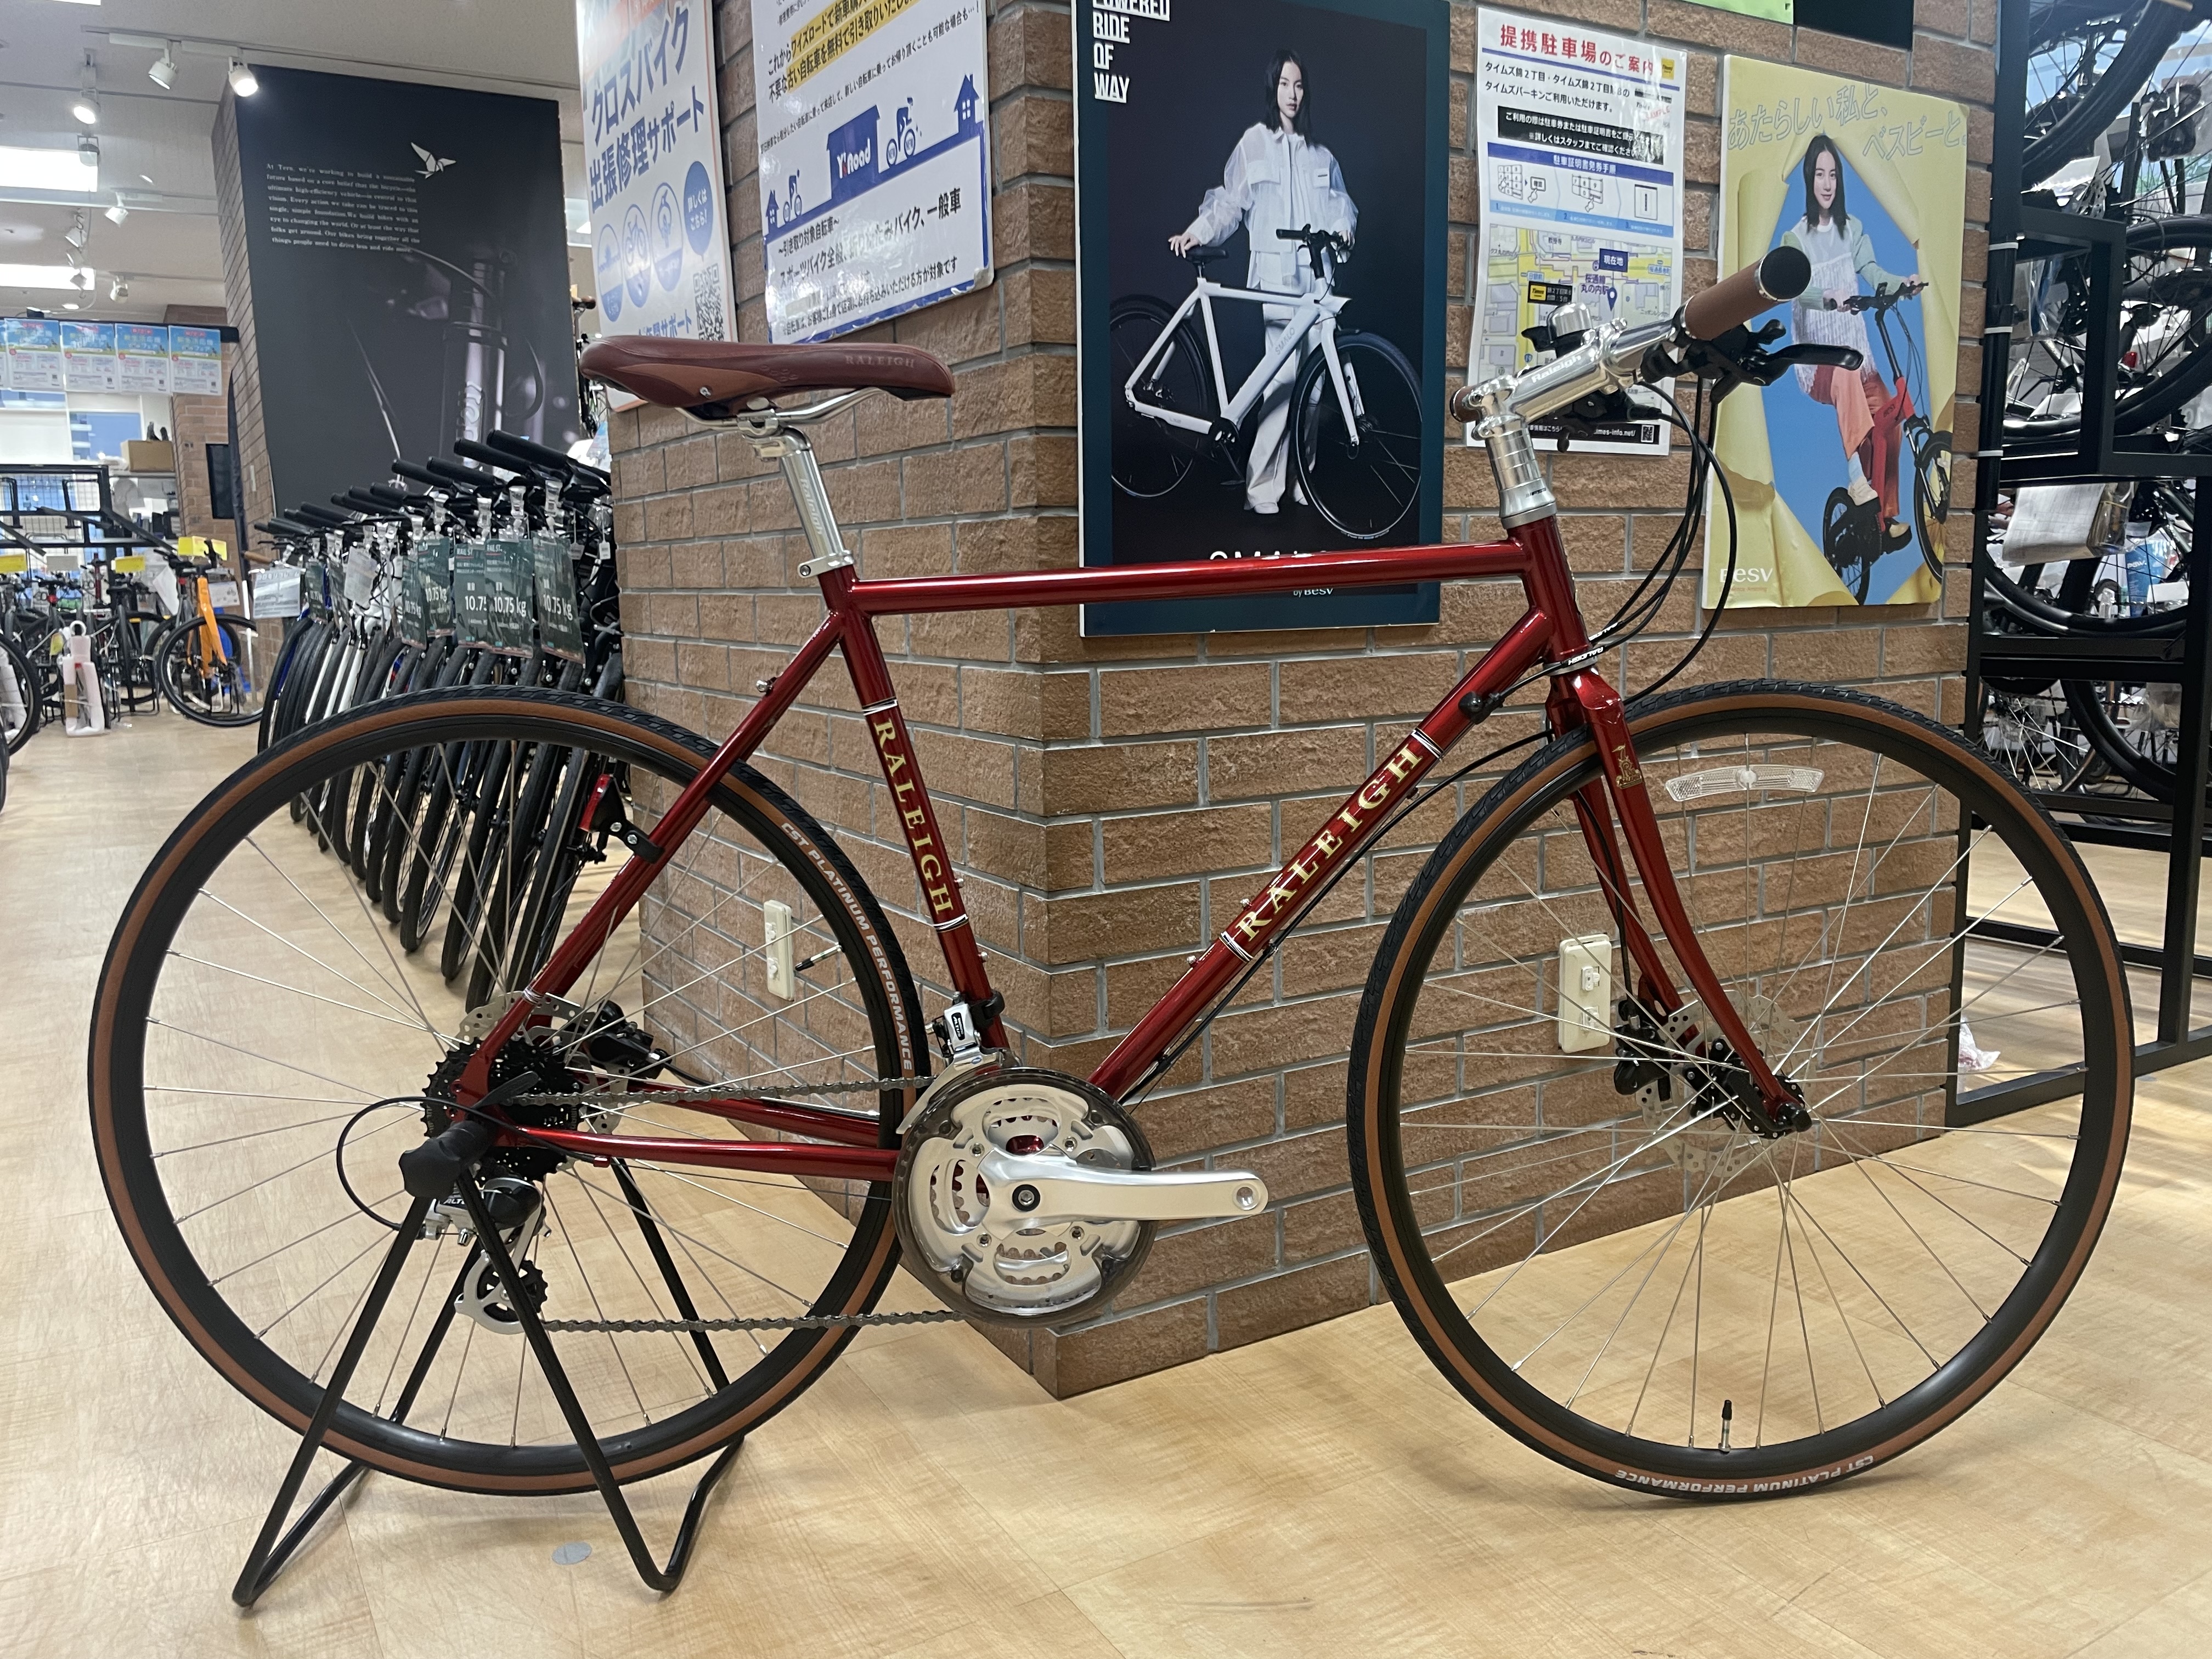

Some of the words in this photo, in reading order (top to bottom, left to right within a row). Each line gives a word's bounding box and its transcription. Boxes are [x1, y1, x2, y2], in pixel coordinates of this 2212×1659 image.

[1093, 11, 1130, 43] RIDE
[1094, 42, 1114, 70] OF
[1500, 24, 1654, 76] 提携駐車場のご案内
[590, 5, 690, 146] クロスバイク
[1094, 72, 1130, 103] WAY
[1727, 82, 1888, 151] あたらしい私と、
[589, 84, 705, 215] 出張修理サポート
[1862, 109, 1968, 160] ベスビーと。
[1604, 255, 1624, 267] 現在地
[845, 354, 916, 369] RALEIGH
[1531, 353, 1582, 383] Raleigh
[799, 476, 823, 536] Raleigh
[493, 596, 515, 614] 10.75
[516, 596, 527, 618] kg
[543, 594, 562, 616] 10.75
[562, 597, 573, 621] kg
[873, 718, 954, 915] RALEIGH
[1235, 743, 1423, 941] RALEIGH
[781, 822, 810, 847] CST
[808, 849, 870, 932] PLATINUM
[865, 934, 913, 1072] PERFORMANCE
[1846, 1454, 1875, 1471] CST
[1614, 1469, 1750, 1493] PERFORMANCE
[1753, 1467, 1842, 1493] PLATINUM
